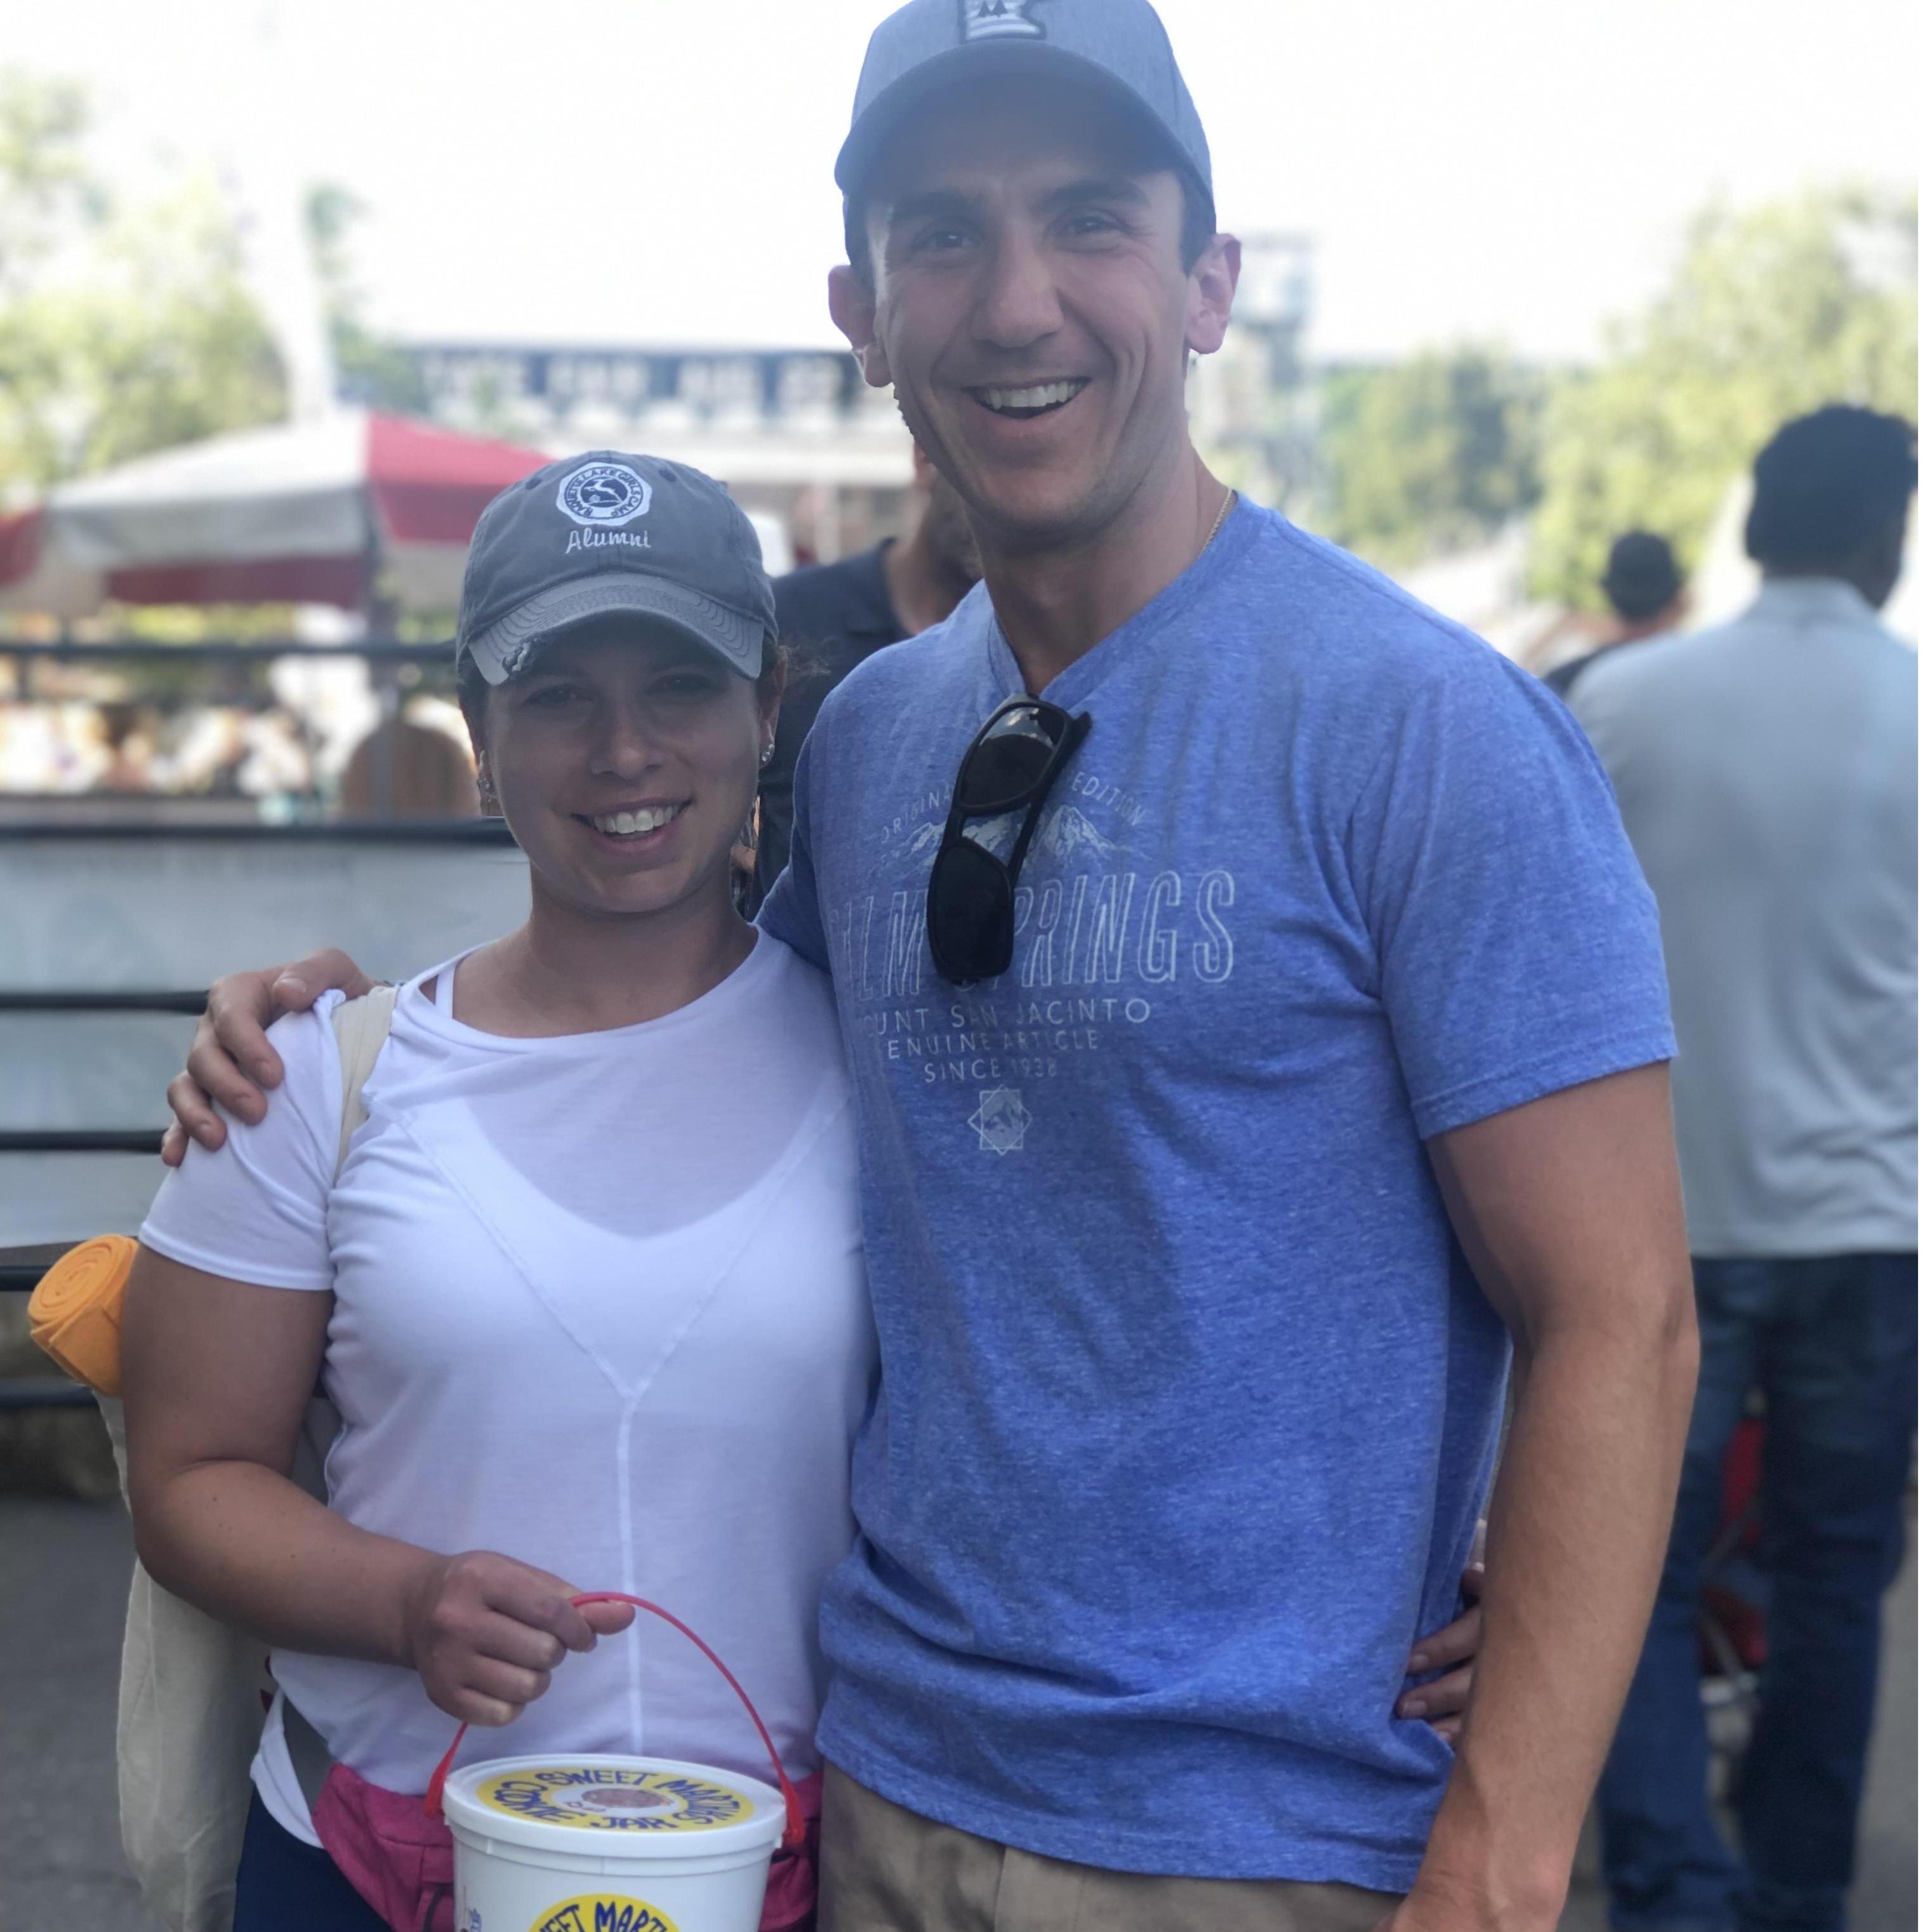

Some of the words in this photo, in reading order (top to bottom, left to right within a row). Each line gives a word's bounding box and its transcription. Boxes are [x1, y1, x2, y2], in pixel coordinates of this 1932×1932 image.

[582, 468, 617, 480] LAKE
[618, 472, 641, 496] GIRLS
[610, 496, 639, 517] CAMP
[566, 527, 652, 553] Alumni
[1071, 771, 1147, 826] EDITION
[1016, 998, 1150, 1025] JACINTO
[889, 1033, 991, 1059] ENUINE
[924, 1058, 1002, 1083] SINCE
[535, 1770, 658, 1785] SWEET
[494, 1781, 587, 1822] COOKIE
[589, 1816, 679, 1829] JAR
